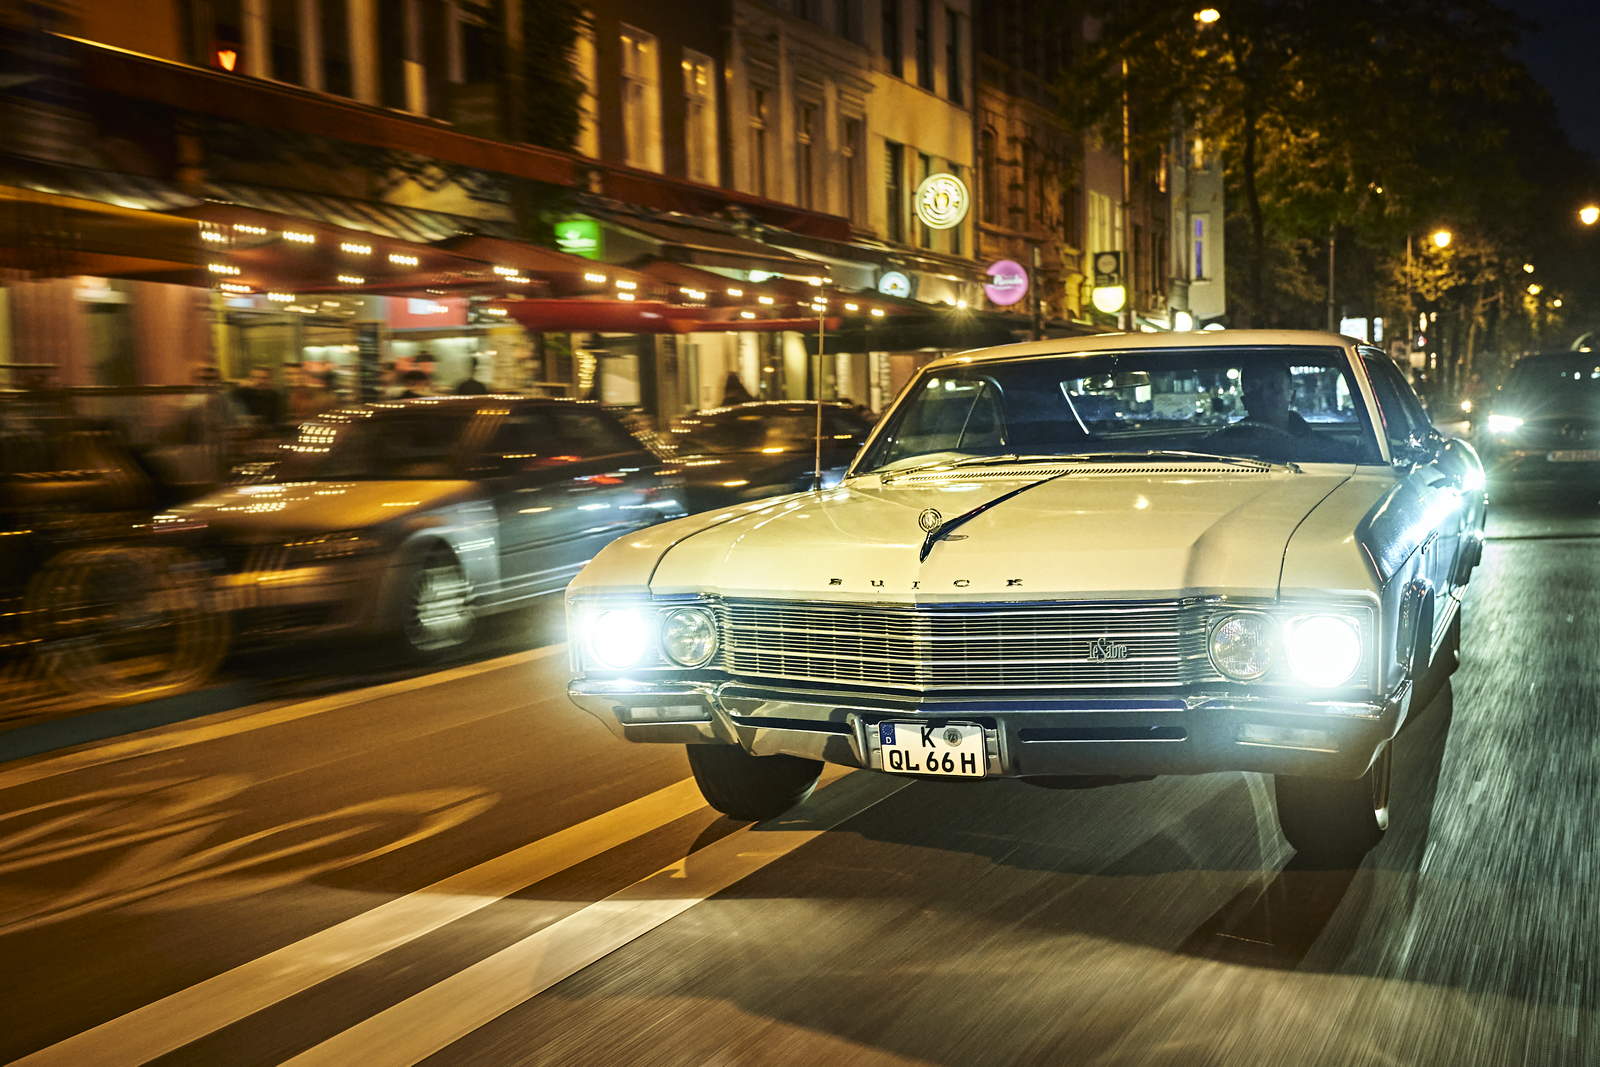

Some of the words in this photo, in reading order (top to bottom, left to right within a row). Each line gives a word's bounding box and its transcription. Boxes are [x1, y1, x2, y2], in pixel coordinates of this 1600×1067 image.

[828, 578, 1024, 590] BUICK
[1087, 637, 1128, 664] LeSabre
[885, 736, 892, 745] D
[920, 726, 936, 748] K
[888, 749, 920, 771] QL
